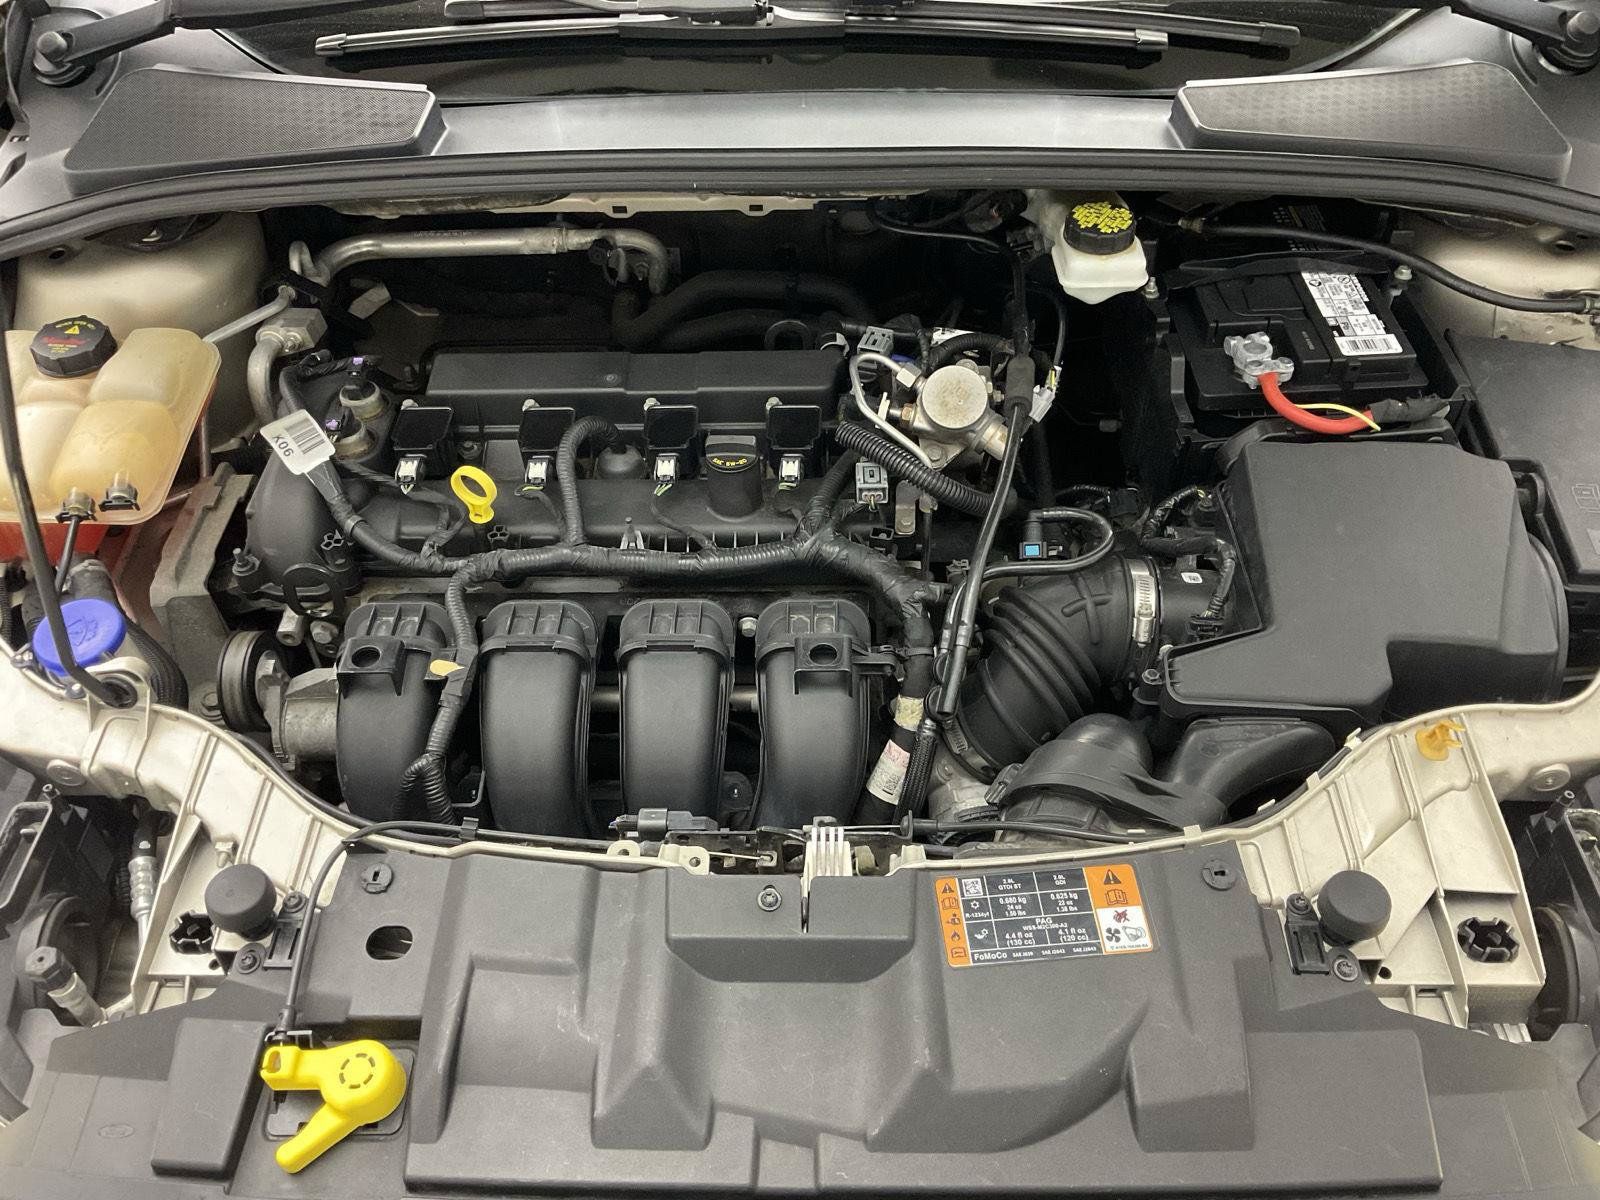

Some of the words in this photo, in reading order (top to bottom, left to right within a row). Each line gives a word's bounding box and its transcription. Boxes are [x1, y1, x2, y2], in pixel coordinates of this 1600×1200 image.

[272, 434, 294, 457] K06
[1017, 896, 1027, 904] kg
[1050, 892, 1068, 900] 0.625
[1068, 891, 1078, 900] kg
[965, 911, 990, 919] R-1234yf
[1035, 917, 1053, 925] PAG
[1006, 939, 1023, 948] (130
[1024, 938, 1036, 946] cc)
[1060, 935, 1076, 943] (120
[1077, 934, 1089, 942] cc)
[974, 952, 1007, 961] FoMoCo
